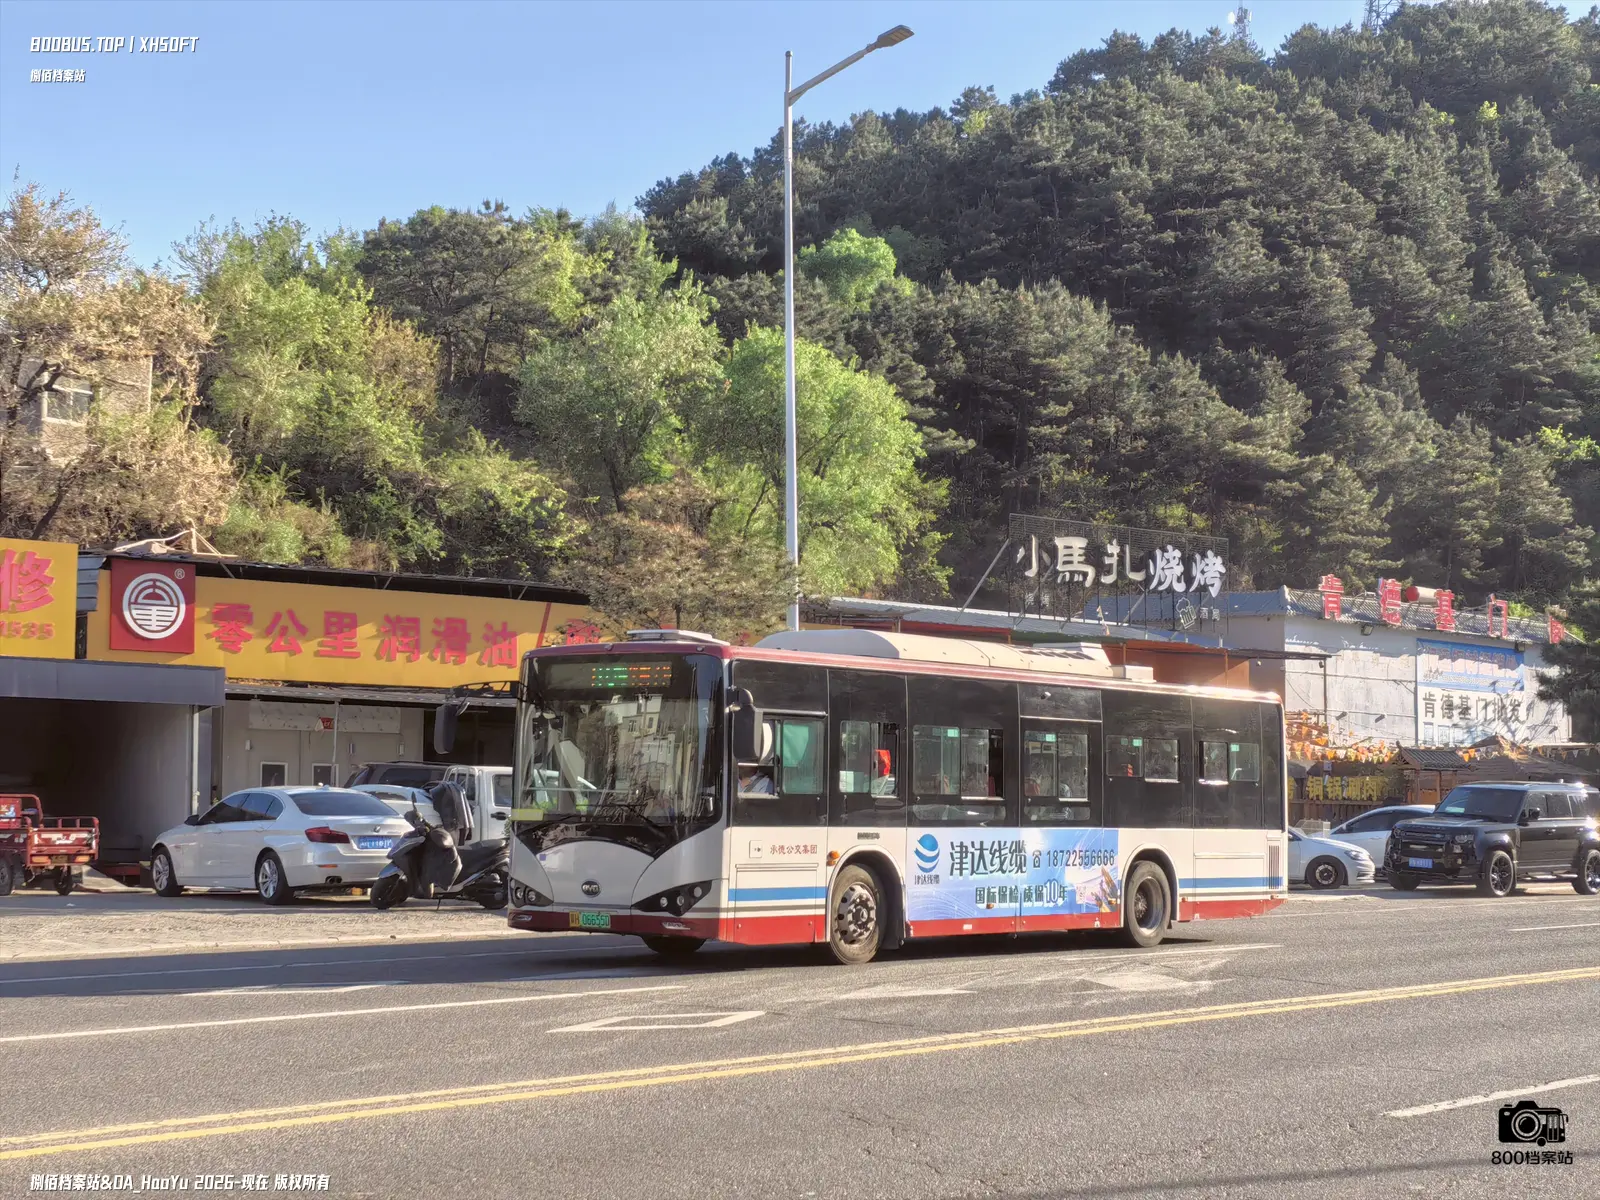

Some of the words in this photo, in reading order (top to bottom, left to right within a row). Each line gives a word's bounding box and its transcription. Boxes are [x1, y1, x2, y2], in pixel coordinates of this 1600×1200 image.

[1016, 534, 1226, 598] 小馬扎烧烤
[209, 602, 519, 668] 零公里润滑油
[769, 844, 818, 855] 承德公交集团
[949, 840, 1028, 876] 津达线缆
[1046, 849, 1115, 867] 18722556666
